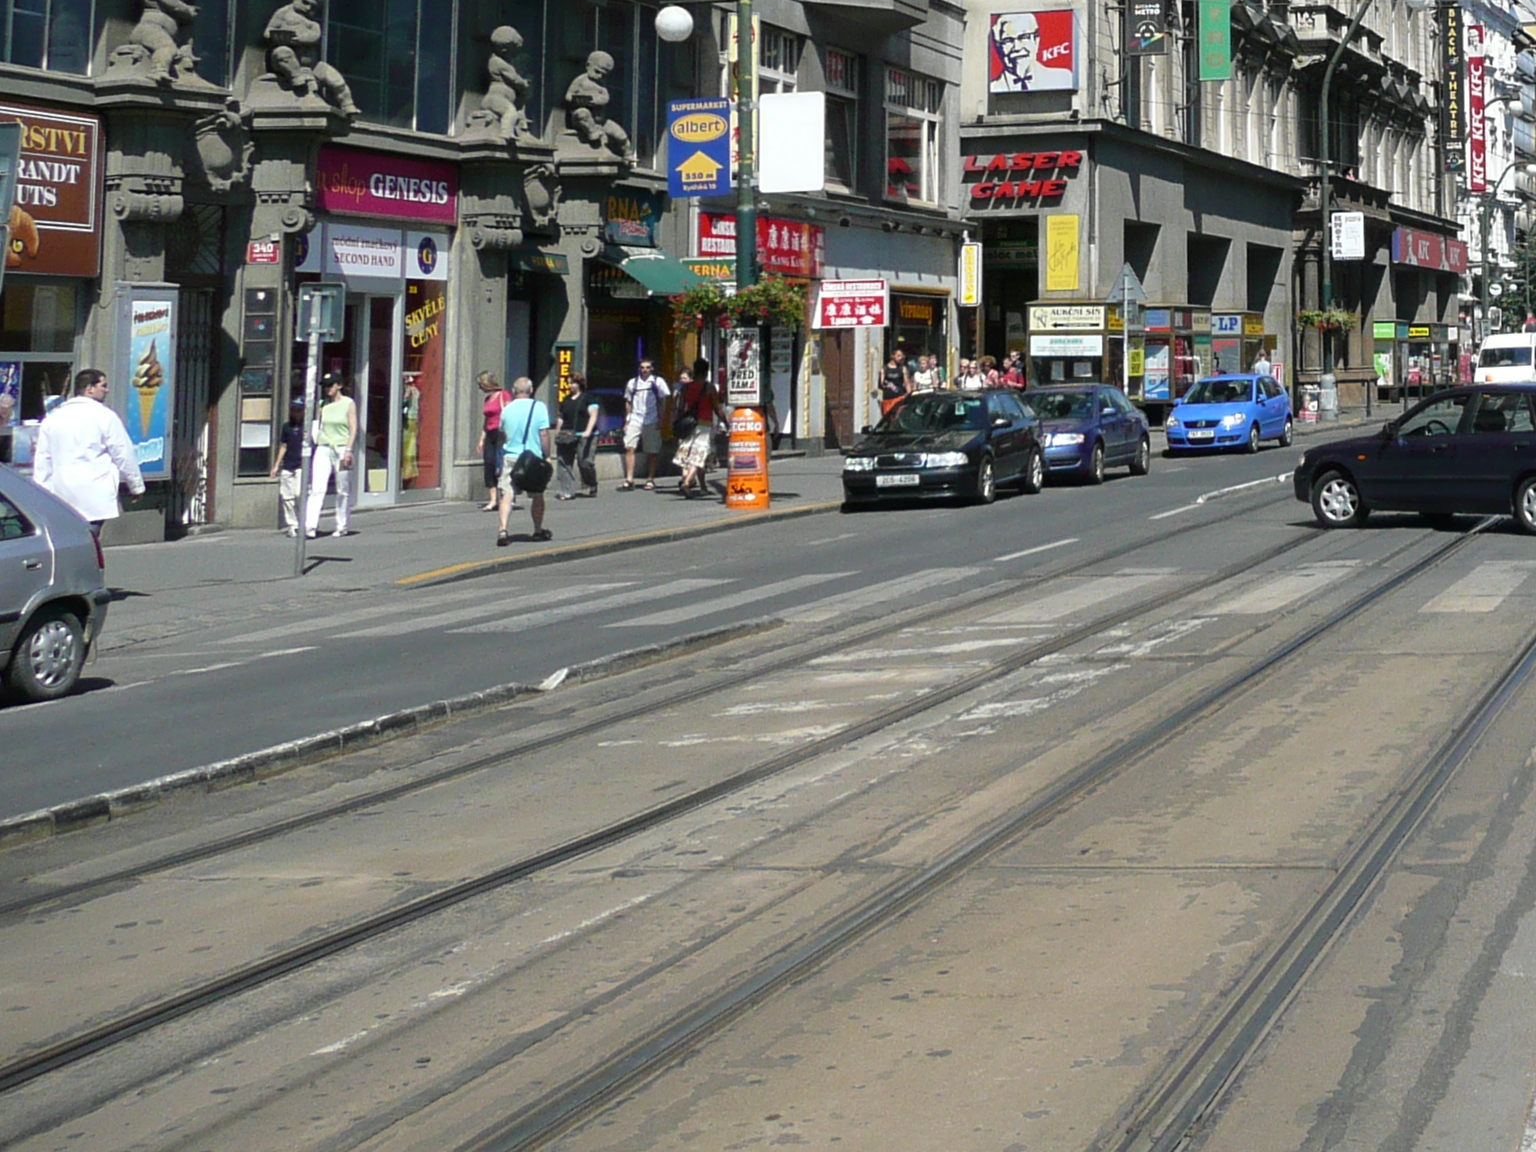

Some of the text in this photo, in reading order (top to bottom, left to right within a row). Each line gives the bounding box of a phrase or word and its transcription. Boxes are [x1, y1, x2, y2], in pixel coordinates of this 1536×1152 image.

[1041, 42, 1071, 61] KFC
[1470, 64, 1483, 97] KFC
[671, 100, 728, 112] SUPERMARKET
[677, 118, 721, 135] albert
[1471, 108, 1484, 141] KFC
[962, 150, 1083, 172] LASER
[1472, 152, 1485, 185] KFC
[369, 173, 449, 205] GENESIS
[970, 180, 1068, 199] GAME
[252, 243, 275, 253] 340
[422, 248, 433, 265] G
[333, 252, 395, 267] SECOND HAND
[405, 291, 446, 330] SKVĚLÉ
[410, 321, 440, 349] CENY
